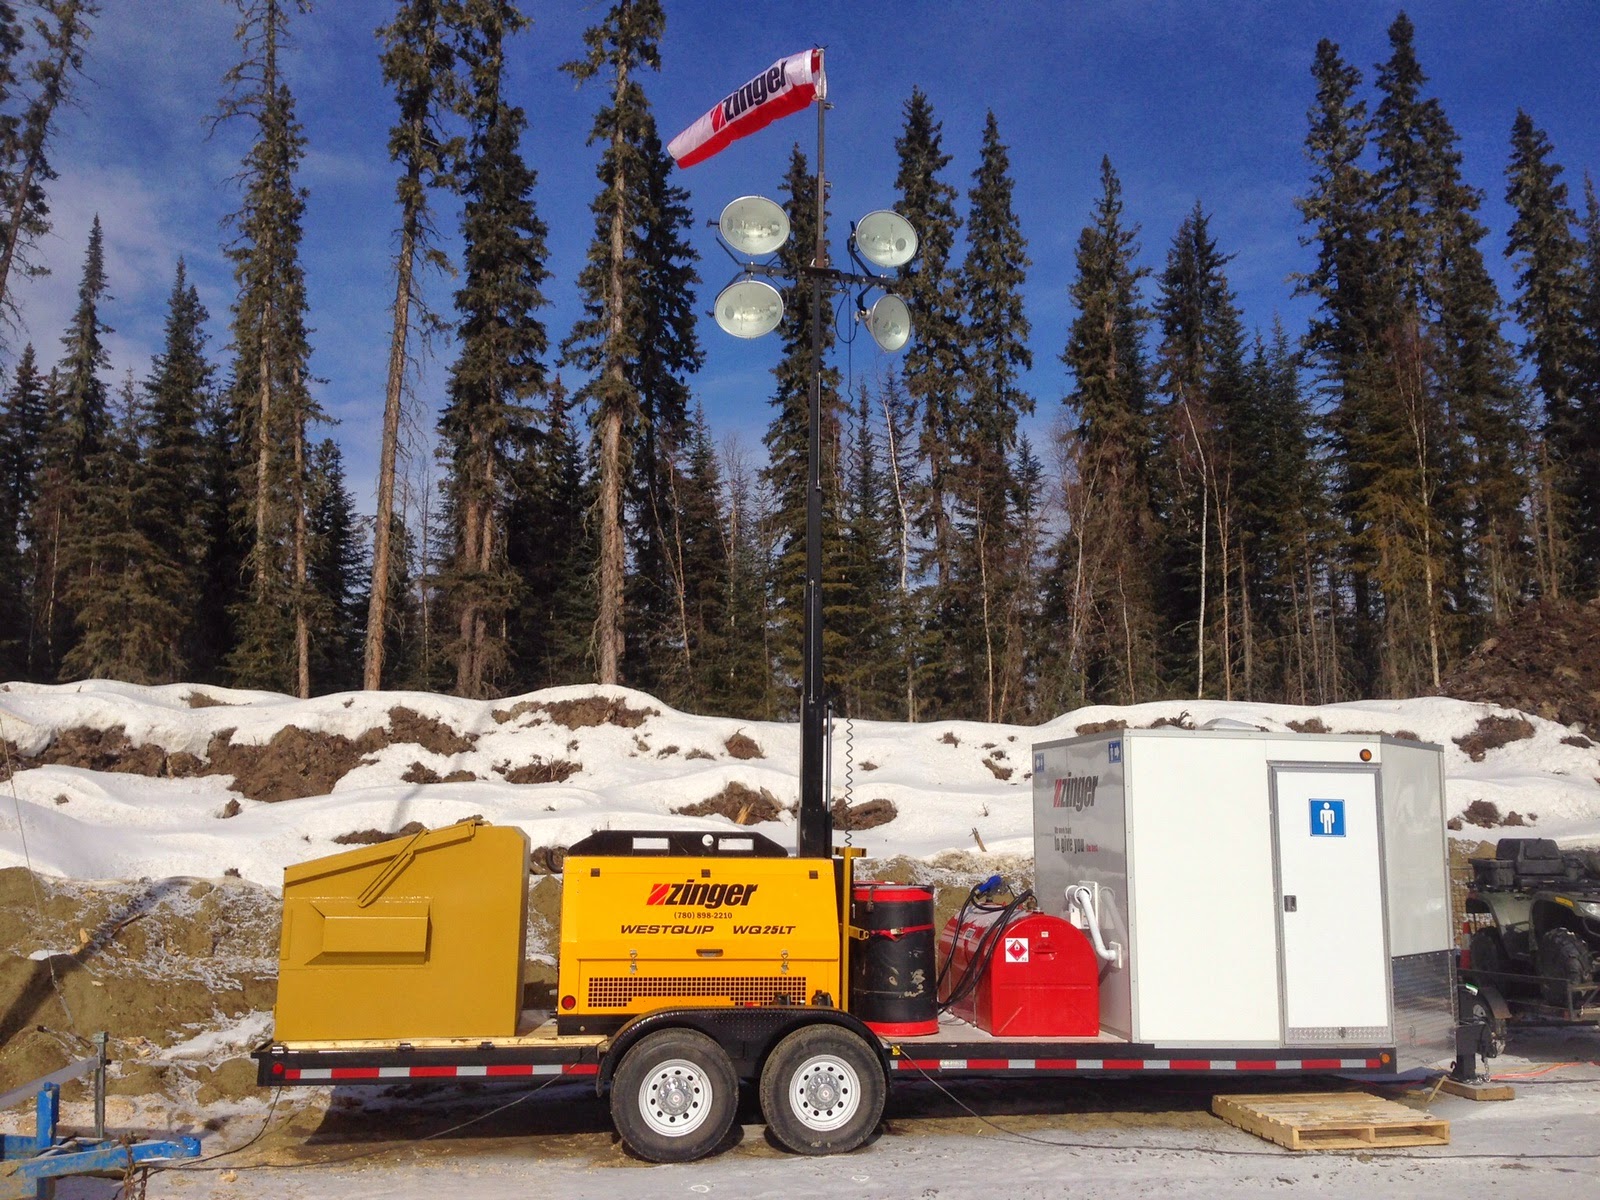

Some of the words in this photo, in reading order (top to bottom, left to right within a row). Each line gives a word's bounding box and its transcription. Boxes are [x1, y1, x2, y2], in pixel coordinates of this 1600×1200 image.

[722, 61, 788, 122] zinger
[1060, 771, 1098, 812] zinger
[1074, 838, 1085, 854] you
[665, 879, 758, 909] zinger
[620, 925, 714, 935] WESTQUIP
